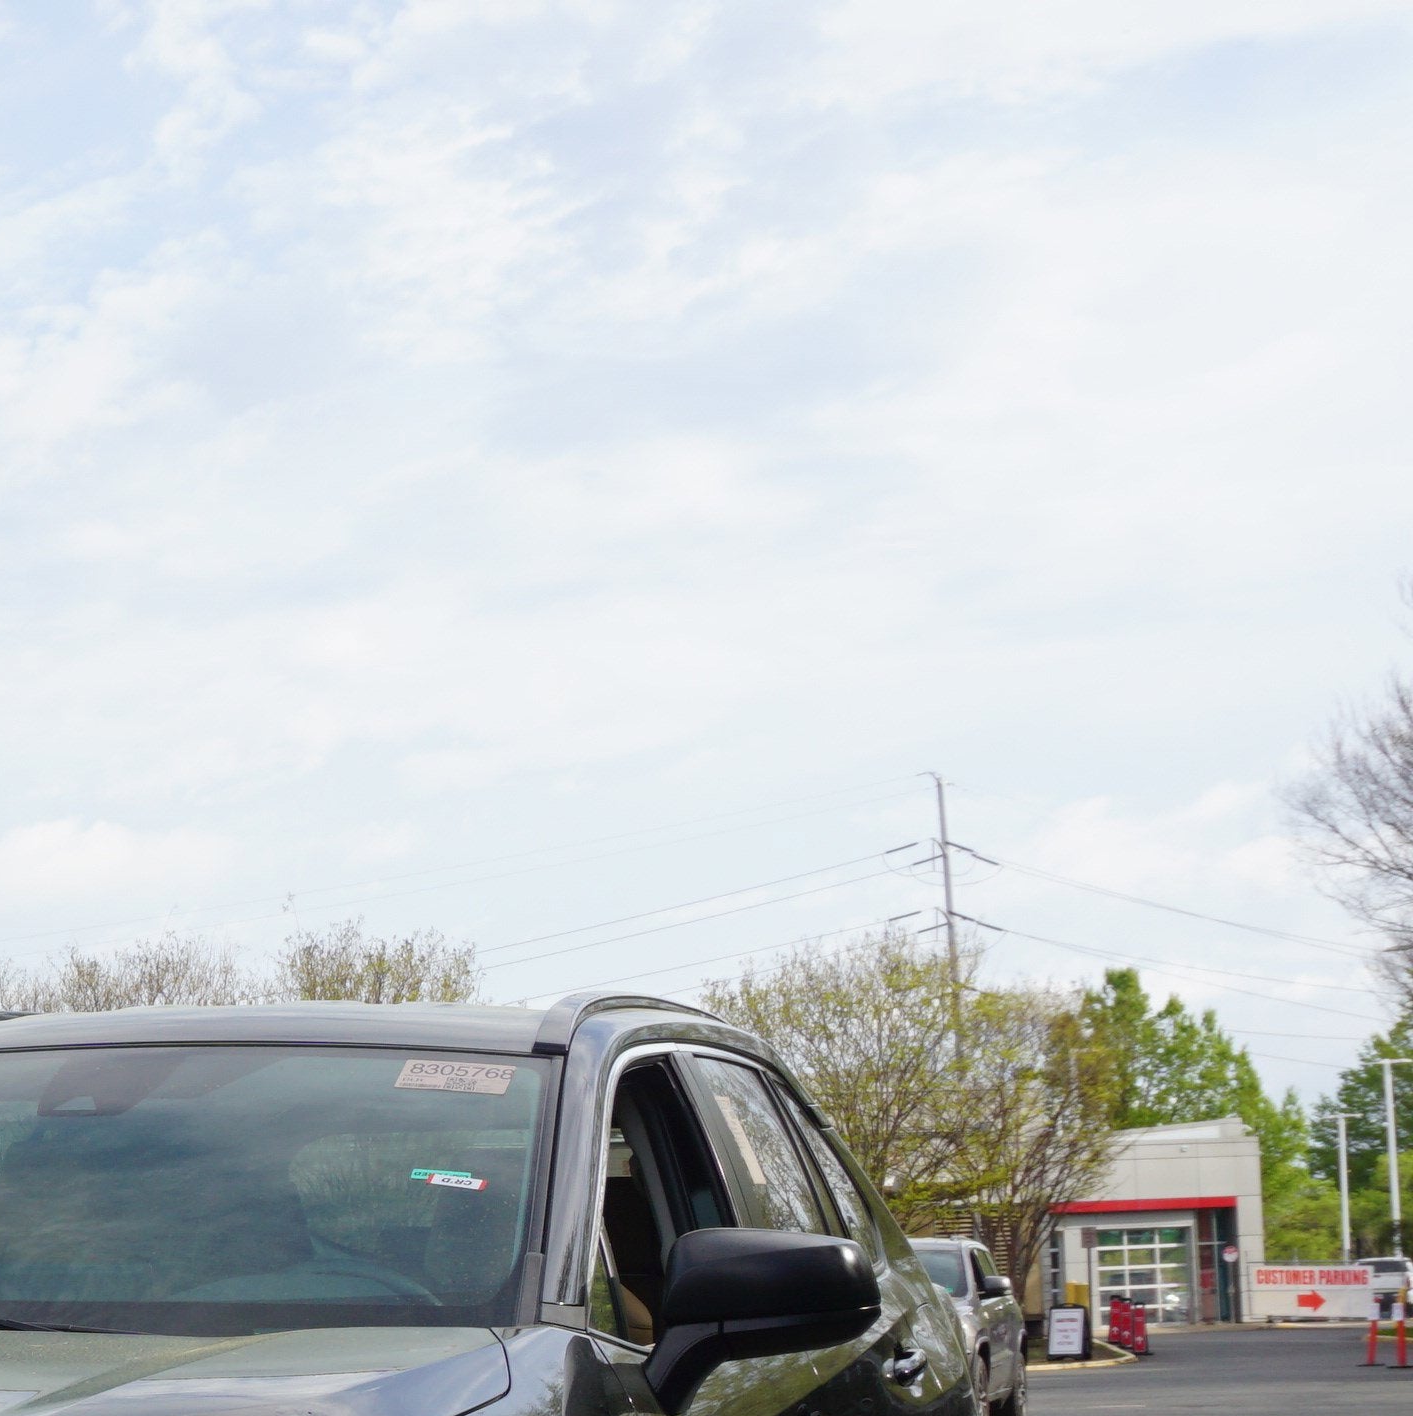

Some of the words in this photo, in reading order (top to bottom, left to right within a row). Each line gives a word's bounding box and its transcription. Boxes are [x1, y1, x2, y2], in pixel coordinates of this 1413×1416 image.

[410, 1063, 515, 1080] 8305768
[1256, 1269, 1316, 1285] CUSTOMER
[1319, 1270, 1369, 1285] PARKING
